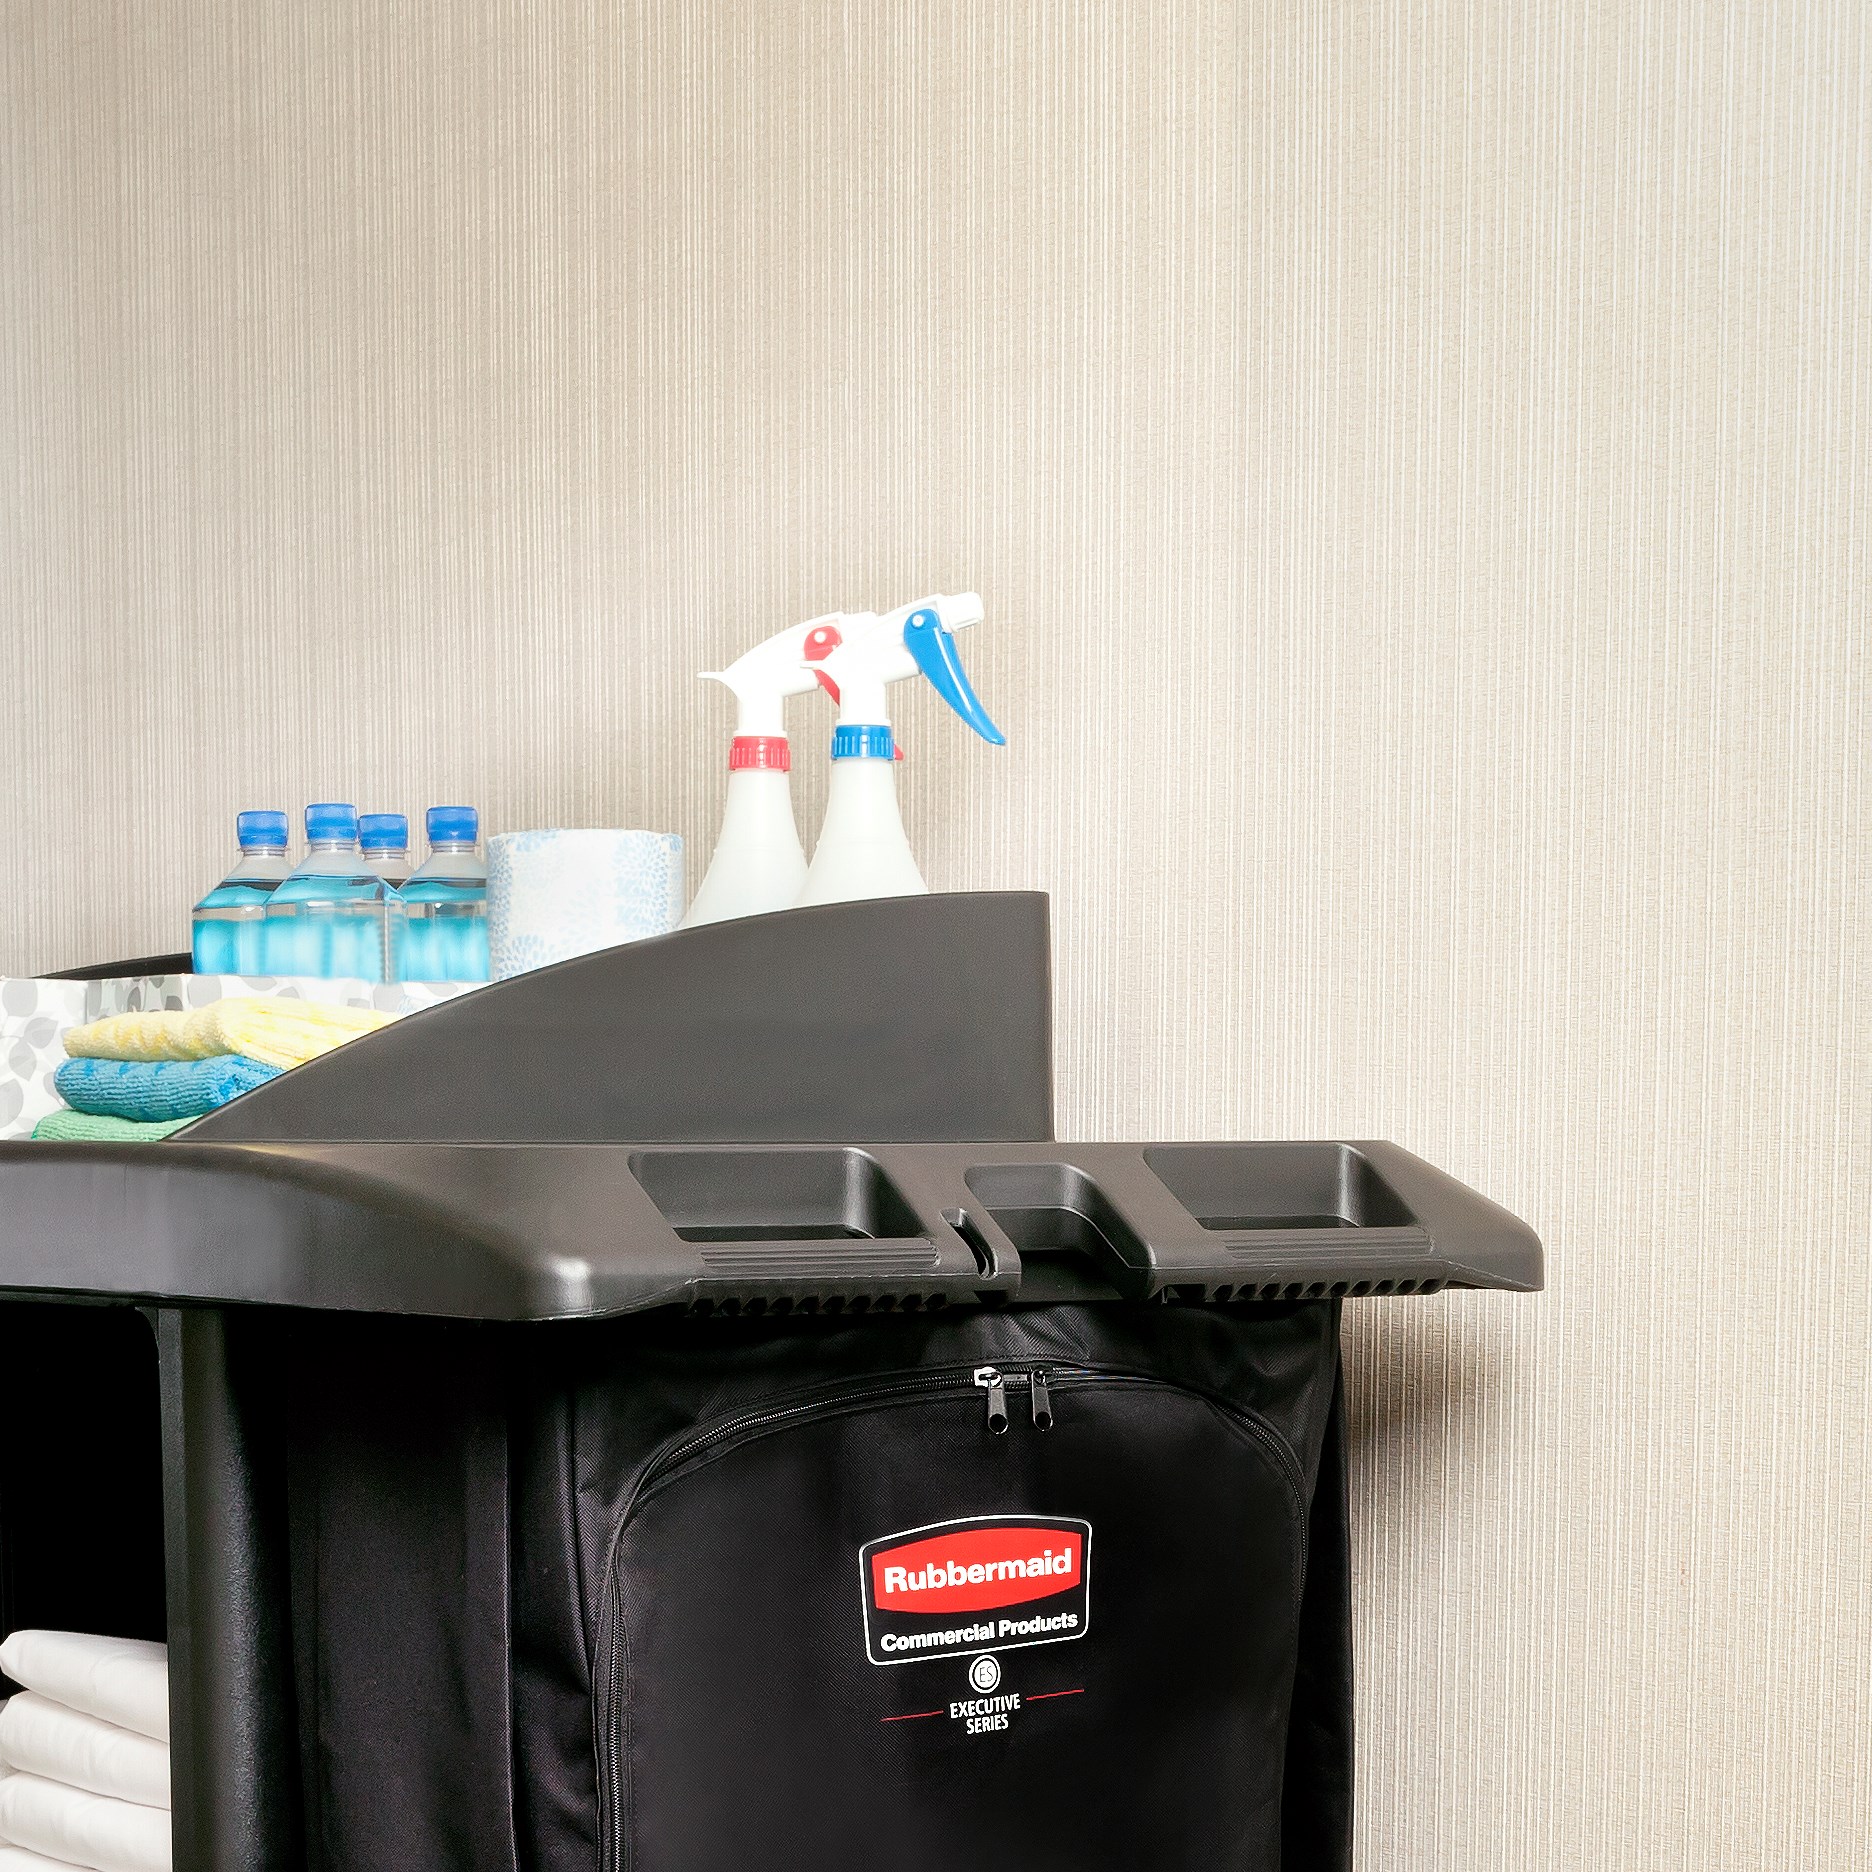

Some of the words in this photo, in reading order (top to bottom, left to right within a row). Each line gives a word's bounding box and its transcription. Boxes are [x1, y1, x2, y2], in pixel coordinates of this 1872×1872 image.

[884, 1547, 1073, 1594] Rubbermaid
[880, 1621, 996, 1652] Commercial
[998, 1611, 1079, 1638] Products
[979, 1665, 994, 1683] ES
[949, 1692, 1021, 1719] EXECUTIVE
[966, 1713, 1009, 1735] SERIES
